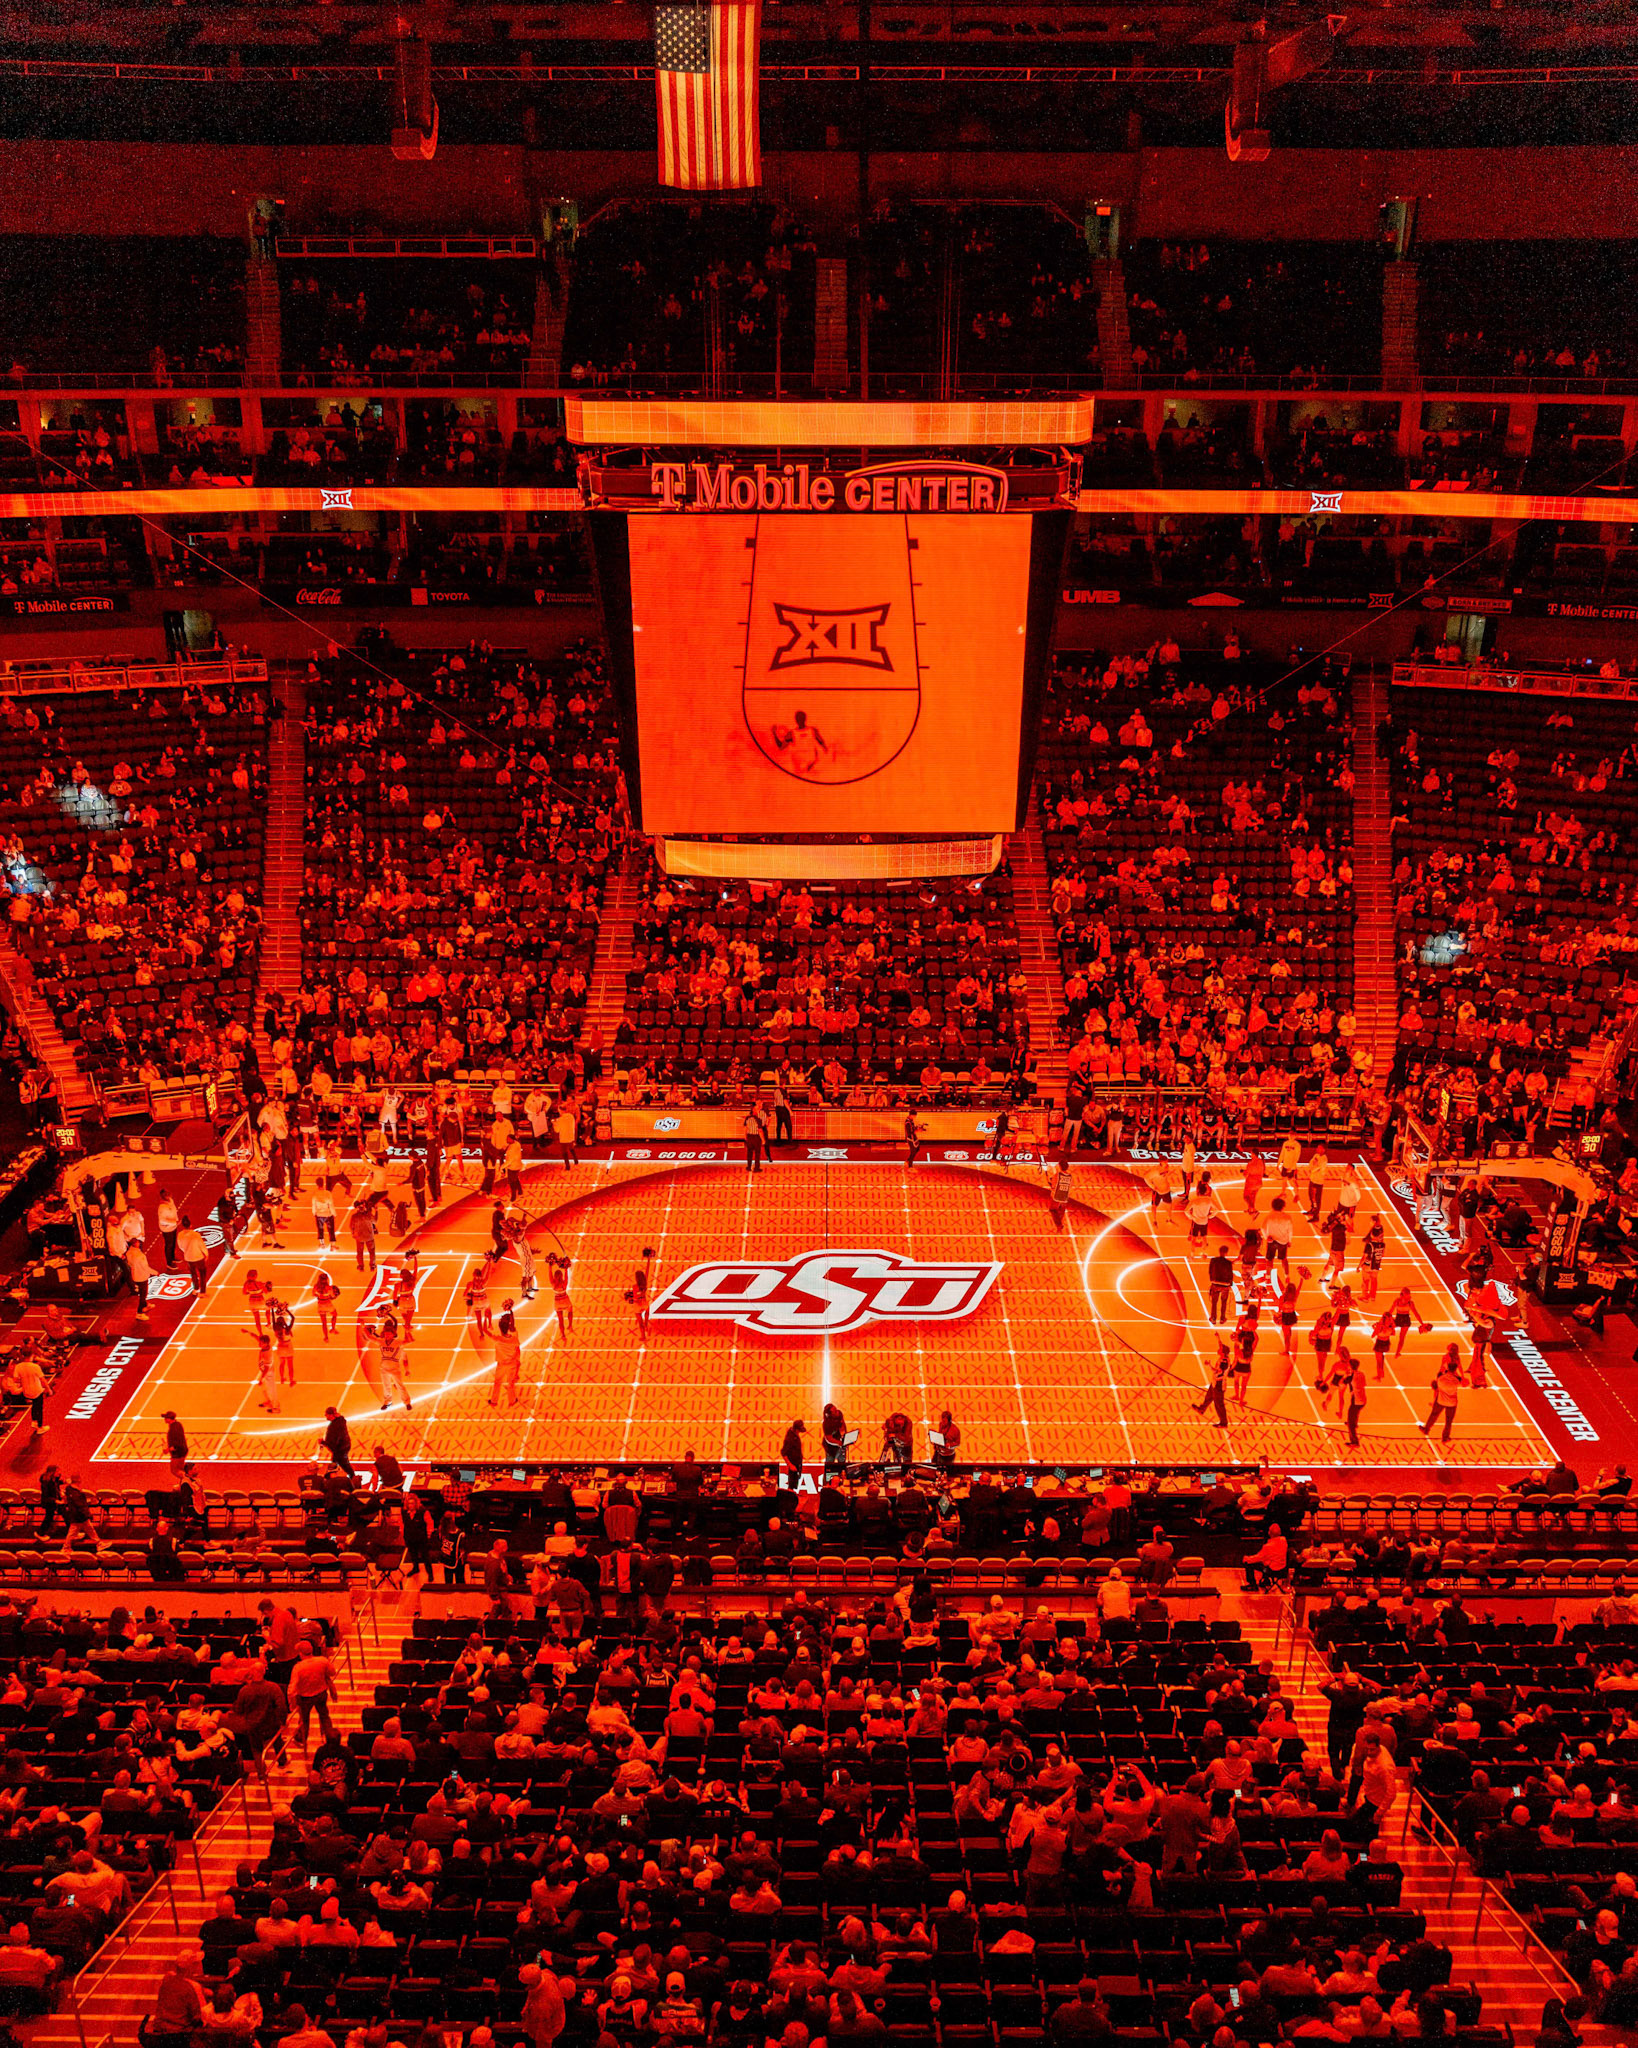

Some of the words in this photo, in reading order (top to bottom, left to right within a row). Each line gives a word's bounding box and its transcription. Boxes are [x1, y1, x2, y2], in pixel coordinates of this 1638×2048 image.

[693, 463, 836, 511] Mobile
[846, 477, 996, 512] CENTER
[295, 587, 344, 606] Coca-Cola
[430, 592, 471, 602] TOYOTA
[1062, 589, 1121, 604] UMB
[27, 600, 68, 613] Mobile
[70, 601, 110, 611] CENTER
[1559, 603, 1600, 617] Mobile
[1601, 608, 1638, 620] CENTE
[769, 602, 894, 672] XII
[653, 1116, 682, 1133] OSU
[56, 1128, 76, 1137] 20:00
[61, 1137, 74, 1146] 30
[1581, 1135, 1601, 1143] 20:00
[1583, 1143, 1597, 1153] 30
[657, 1151, 676, 1159] GO
[677, 1151, 697, 1159] GO
[697, 1151, 717, 1159] GO
[976, 1152, 993, 1160] GO
[1015, 1152, 1033, 1160] GO
[91, 1218, 103, 1229] GO
[92, 1228, 104, 1239] GO
[1552, 1226, 1566, 1236] GO
[93, 1238, 105, 1249] GO
[1551, 1235, 1564, 1246] GO
[1549, 1245, 1563, 1256] GO
[163, 1279, 188, 1295] 66
[649, 1248, 1005, 1336] OSU
[64, 1367, 124, 1420] KANSAS
[103, 1335, 145, 1366] CITY
[1501, 1328, 1564, 1388] T-MOBILE
[1542, 1389, 1601, 1442] CENTER
